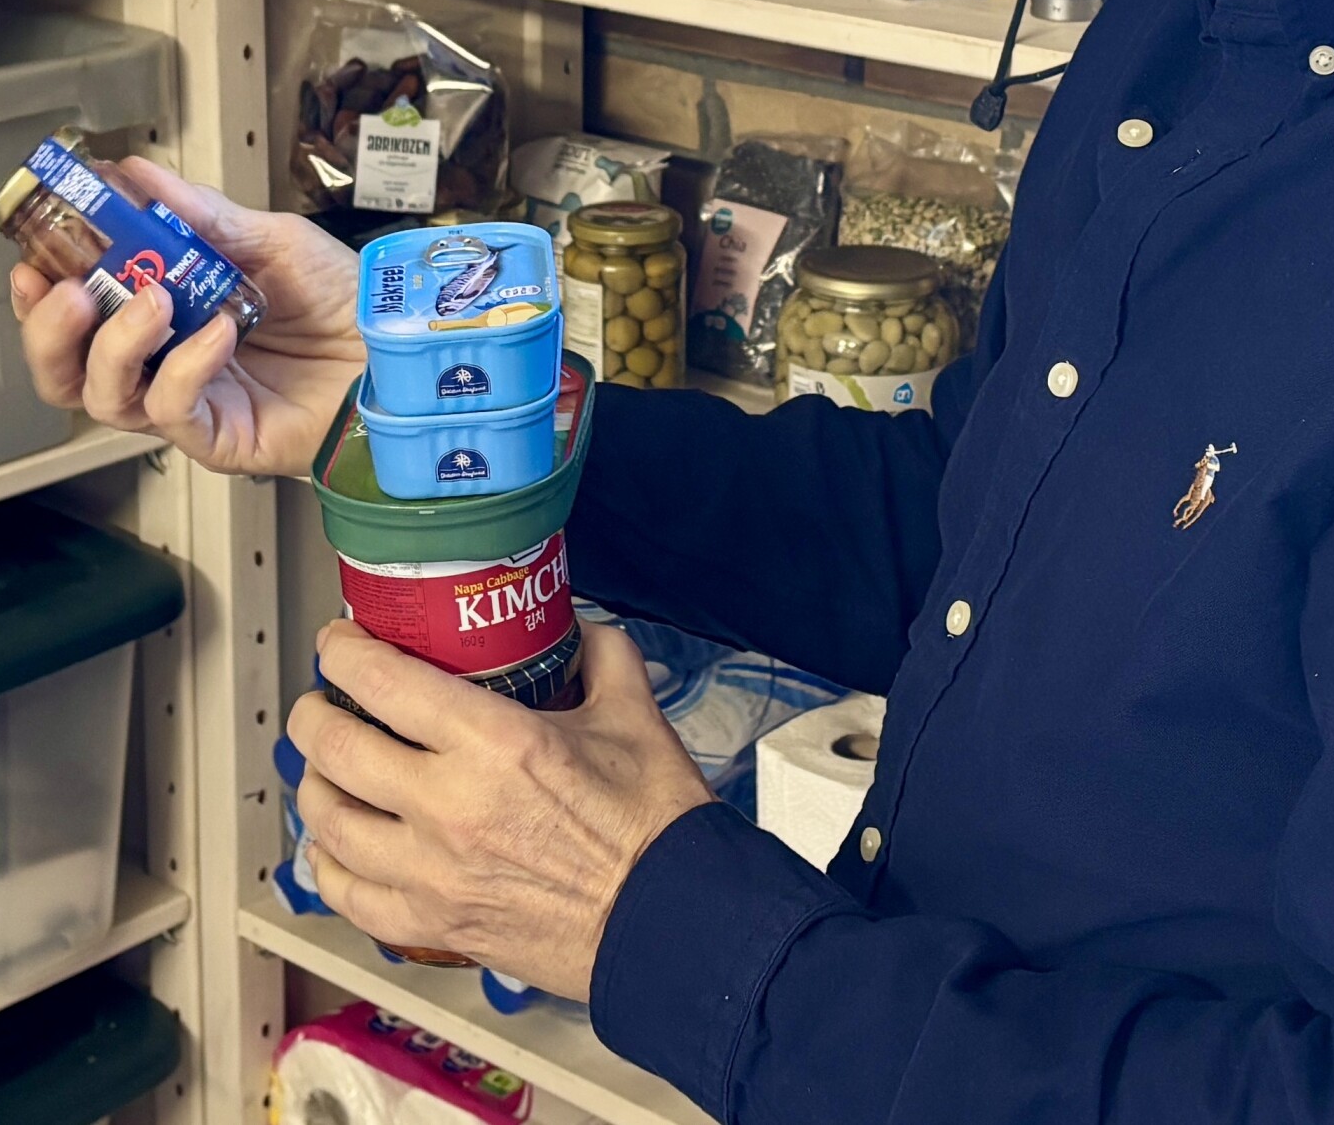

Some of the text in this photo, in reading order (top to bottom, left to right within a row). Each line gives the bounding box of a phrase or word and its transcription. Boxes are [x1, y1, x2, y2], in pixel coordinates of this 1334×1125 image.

[164, 246, 200, 284] PRINCES
[371, 265, 405, 314] Makreel
[453, 566, 530, 596] Napa Cabbage
[524, 606, 546, 632] 김치
